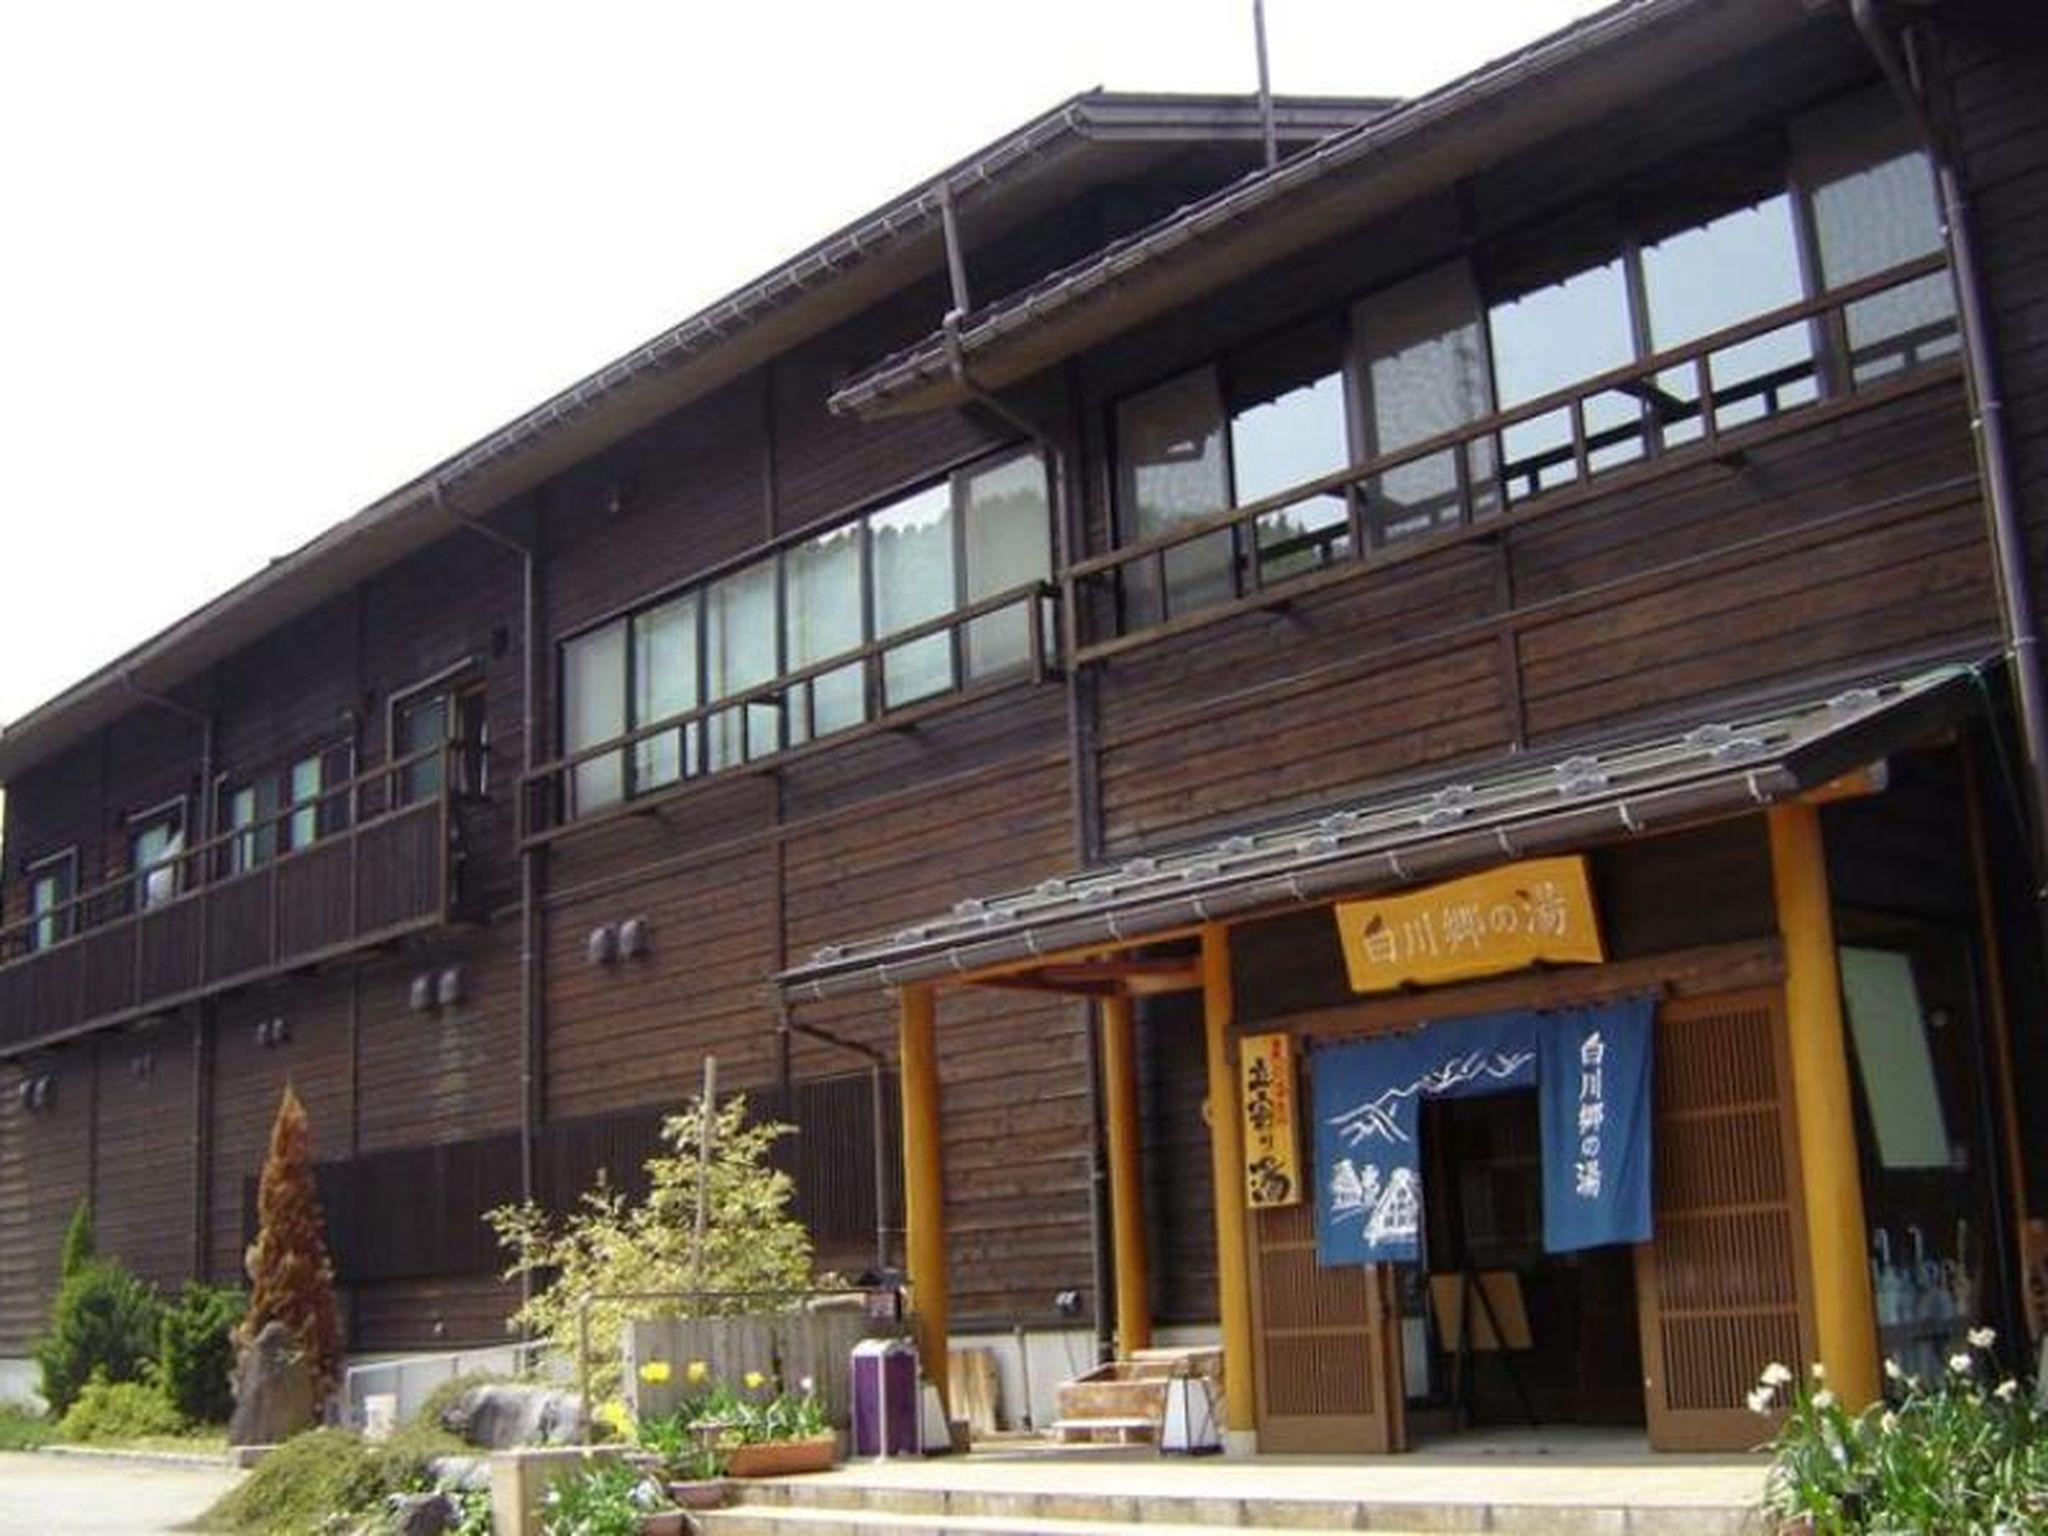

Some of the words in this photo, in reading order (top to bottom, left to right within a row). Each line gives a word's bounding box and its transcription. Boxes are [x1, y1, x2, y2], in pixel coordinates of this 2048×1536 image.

[1363, 880, 1567, 964] 白川郷の湯
[1575, 1030, 1605, 1199] 白川郷の湯
